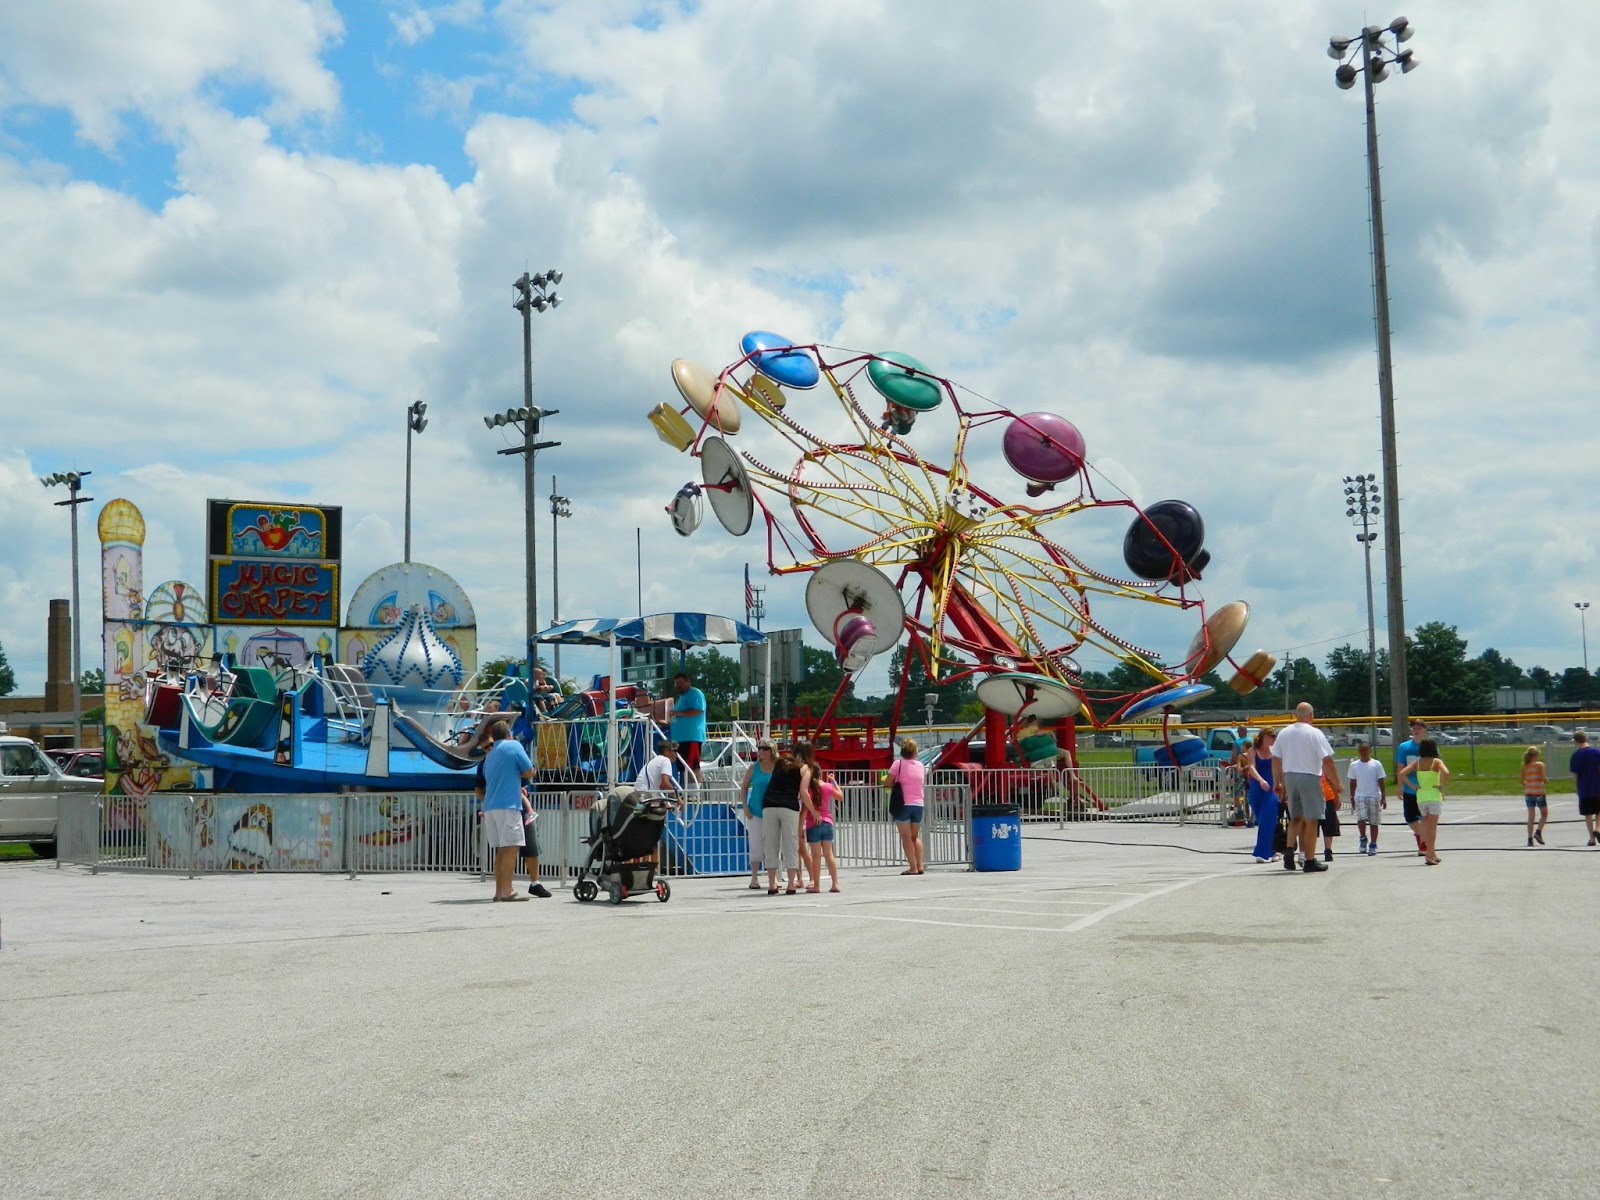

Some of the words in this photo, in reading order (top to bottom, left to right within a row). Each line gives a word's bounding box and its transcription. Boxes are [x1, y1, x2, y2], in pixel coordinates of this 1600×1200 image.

[229, 564, 318, 593] MAGIC
[221, 587, 329, 618] CARPET
[1145, 717, 1163, 725] PIZZA
[935, 788, 956, 801] EXT
[574, 795, 594, 810] EXIT
